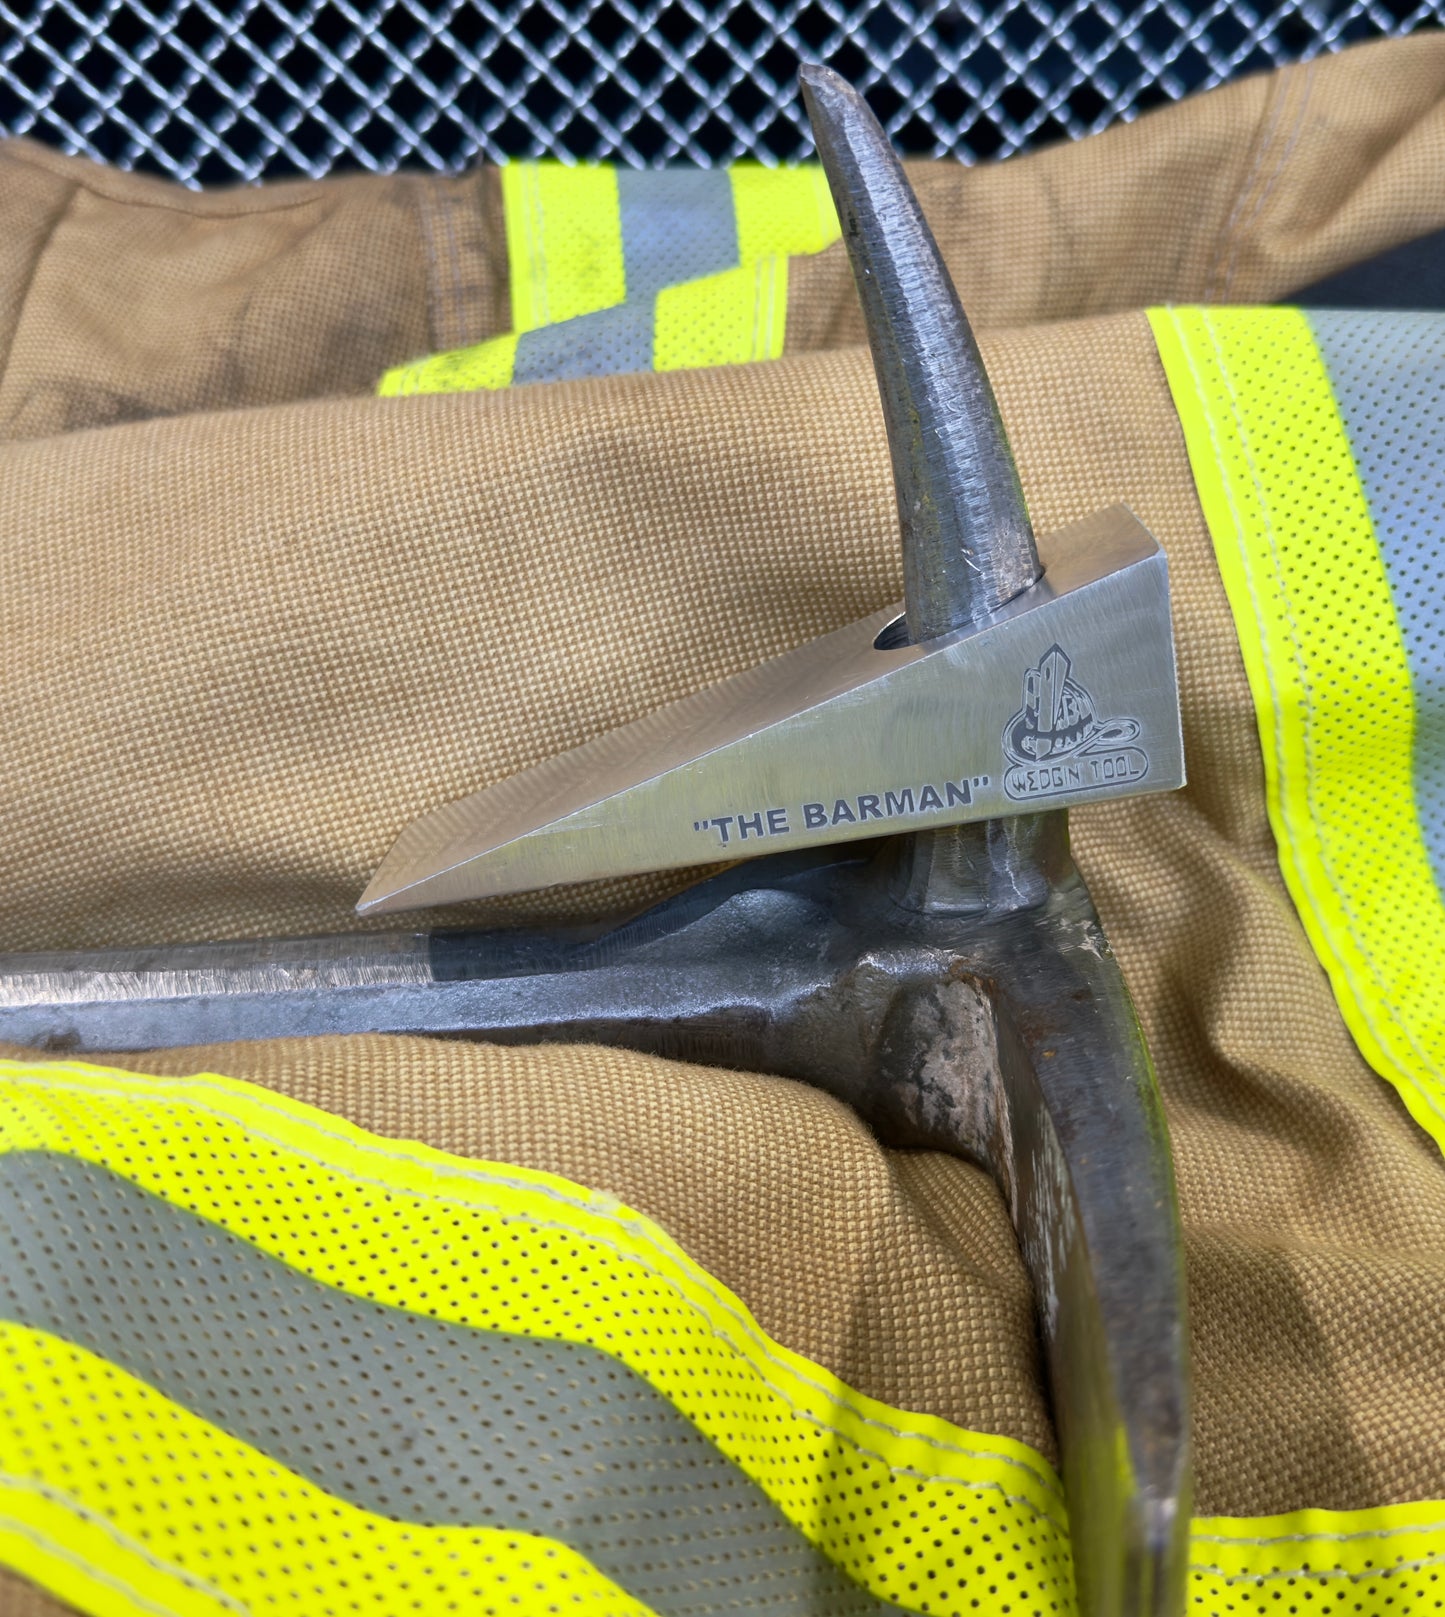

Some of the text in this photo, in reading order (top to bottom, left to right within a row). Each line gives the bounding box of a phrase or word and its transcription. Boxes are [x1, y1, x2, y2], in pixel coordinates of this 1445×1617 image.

[1090, 756, 1140, 779] TOOL
[694, 776, 989, 842] "THE BARMAN"
